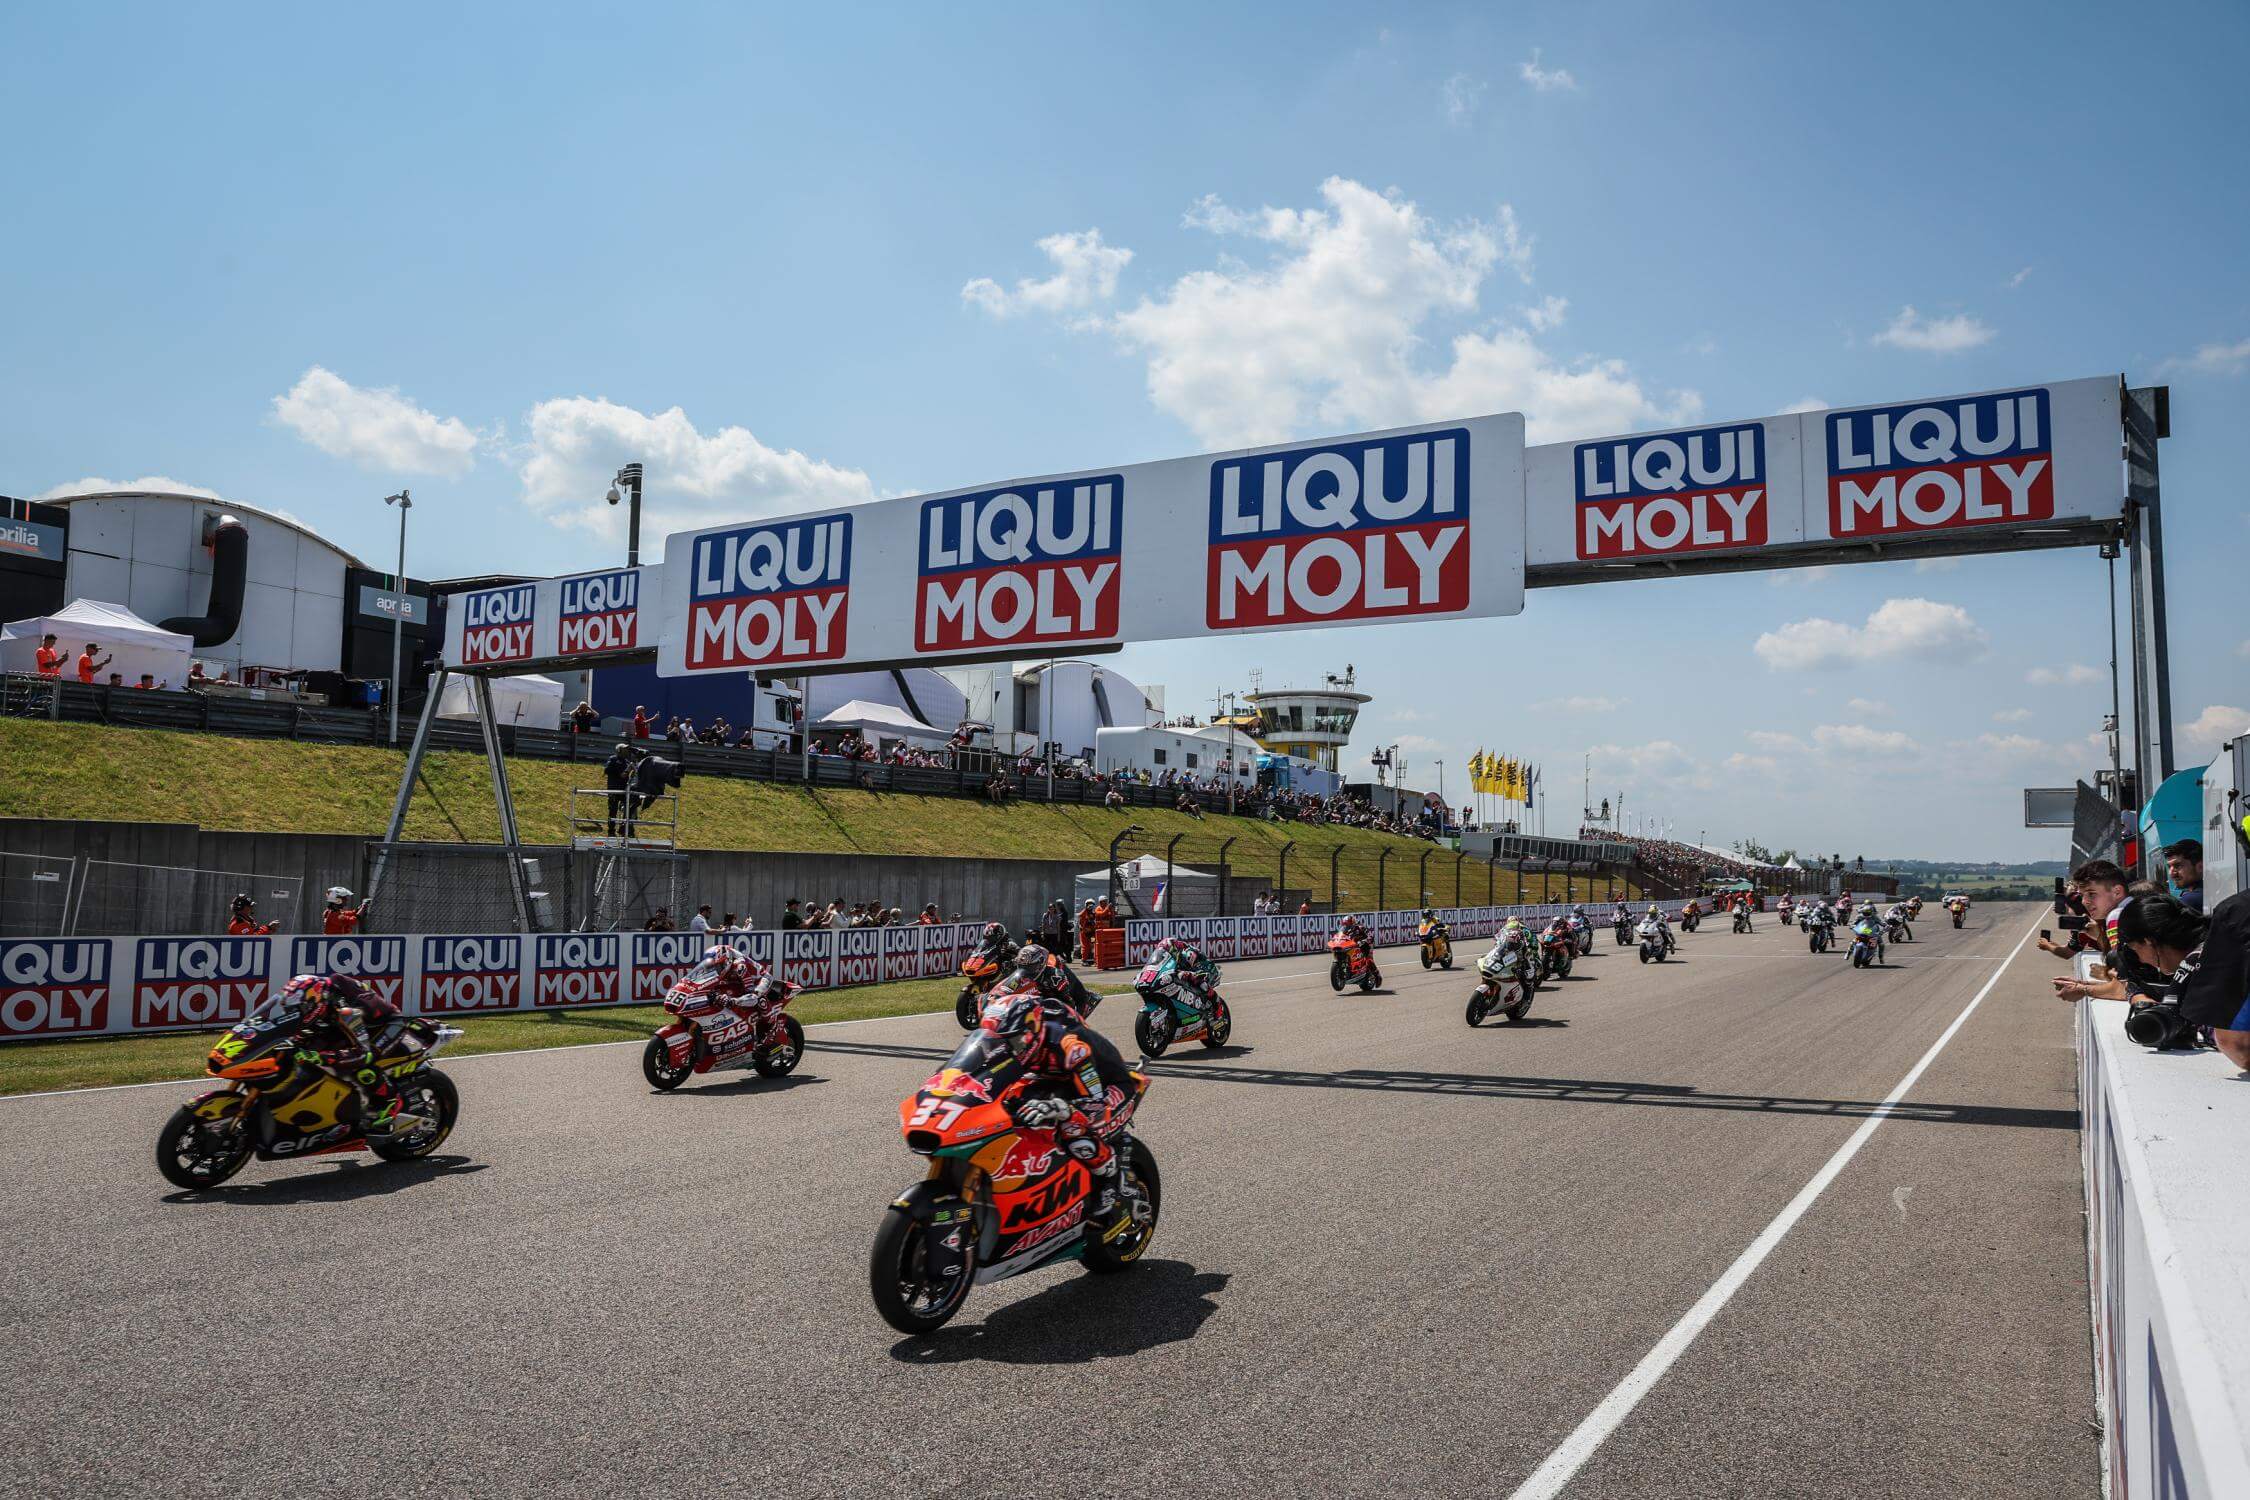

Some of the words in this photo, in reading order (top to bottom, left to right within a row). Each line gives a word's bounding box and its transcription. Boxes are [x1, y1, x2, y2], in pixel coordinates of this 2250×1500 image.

[1837, 396, 2040, 470] LIQUI
[1584, 430, 1755, 496] LIQUI
[1222, 439, 1456, 536] LIQUI
[1840, 460, 2049, 531] MOLY
[928, 484, 1113, 569] LIQUI
[1585, 490, 1763, 554] MOLY
[698, 521, 845, 594] LIQUI
[1220, 526, 1466, 619] MOLY
[468, 590, 533, 626] LIQUI
[564, 574, 635, 613] LIQUI
[924, 562, 1118, 643] MOLY
[465, 624, 533, 661] MOLY
[561, 612, 636, 652] MOLY
[693, 592, 846, 662] MOLY
[960, 926, 985, 946] LIQU
[1130, 922, 1163, 941] LIQUI
[1170, 921, 1200, 939] LIQUI
[1208, 920, 1234, 938] LIQUI
[1242, 918, 1267, 936] LIQUI
[1273, 918, 1296, 934] LIQUI
[1302, 917, 1324, 933] LIQUI
[1379, 913, 1397, 927] LIQUI
[539, 936, 616, 968] LIQUI
[636, 936, 701, 967] LIQUI
[784, 934, 831, 960] LIQUI
[840, 931, 877, 956] LIQUI
[884, 928, 918, 952] LIQUI
[924, 927, 953, 950] LIQUI
[1207, 941, 1234, 960] MOLY
[1242, 938, 1268, 957] MOLY
[1272, 936, 1297, 955] MOLY
[1301, 935, 1324, 952] MOLY
[1379, 929, 1397, 944] MOLY
[2, 943, 104, 986] QUI
[143, 941, 269, 981] LIQUI
[298, 940, 399, 975] LIQUI
[426, 939, 516, 971] LIQUI
[840, 959, 878, 983] MOLY
[884, 955, 918, 978] MOLY
[923, 953, 953, 975] MOLY
[539, 971, 618, 1004] MOLY
[784, 962, 831, 987] MOLY
[141, 983, 267, 1024] MOLY
[425, 975, 520, 1009] MOLY
[1, 987, 106, 1031] OLY
[213, 1033, 247, 1058] 14
[909, 1098, 970, 1131] 37
[271, 1134, 323, 1154] elf
[1003, 1165, 1081, 1228] KTM
[1001, 1200, 1083, 1258] AVANT
